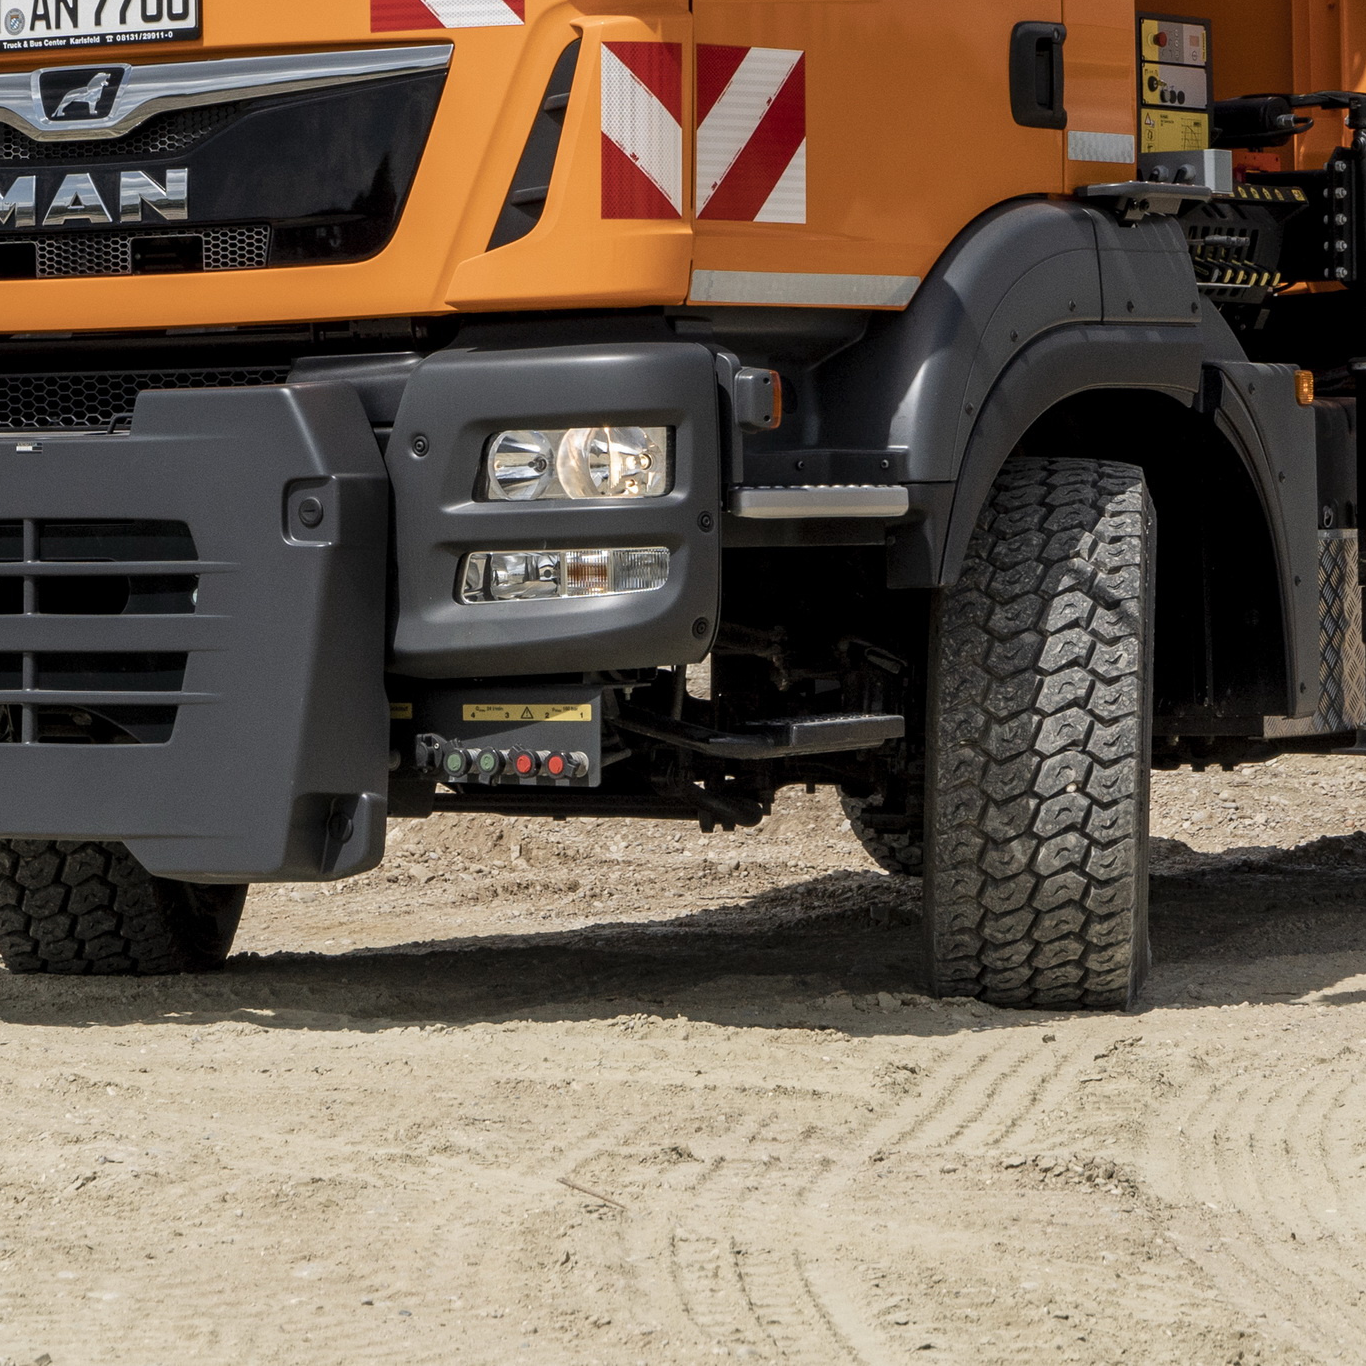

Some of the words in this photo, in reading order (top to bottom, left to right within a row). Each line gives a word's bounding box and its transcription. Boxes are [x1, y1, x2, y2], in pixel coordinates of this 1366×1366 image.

[2, 41, 22, 49] Truck
[23, 40, 29, 48] &
[29, 39, 43, 47] Bus
[43, 38, 67, 46] Center
[69, 35, 101, 45] Karlsfeld
[115, 30, 174, 42] 08131/29911-0
[504, 711, 510, 719] 3
